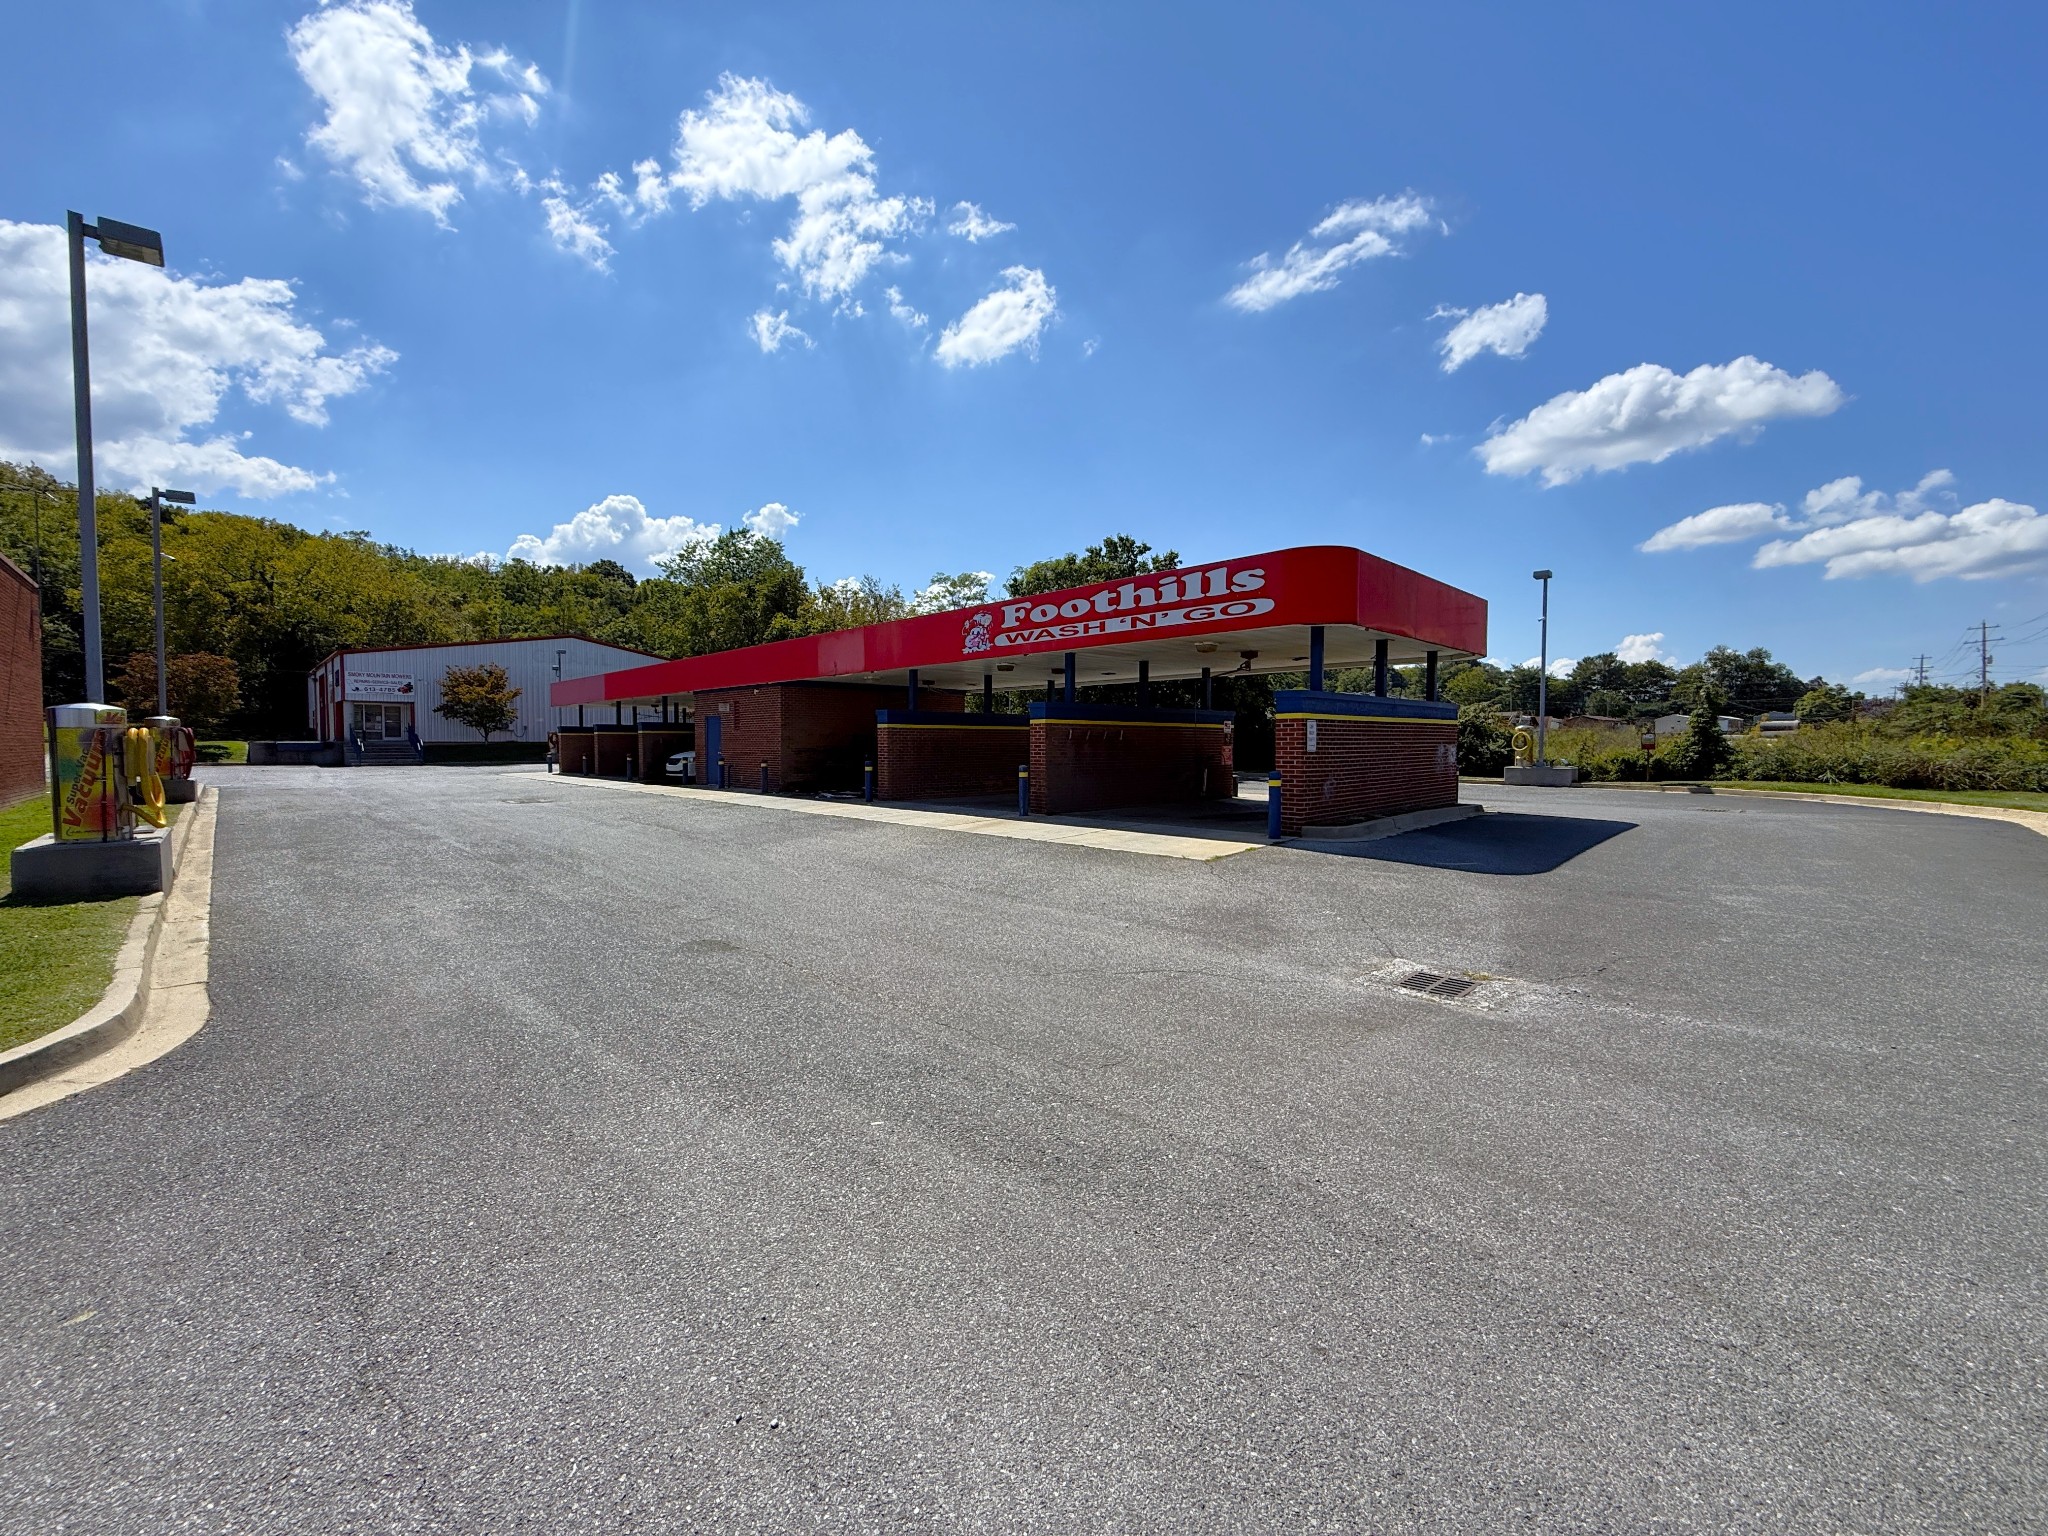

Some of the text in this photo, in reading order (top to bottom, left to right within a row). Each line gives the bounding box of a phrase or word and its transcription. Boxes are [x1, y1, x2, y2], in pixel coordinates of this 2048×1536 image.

[1000, 567, 1266, 628] Foothills
[1004, 619, 1106, 642] WASH
[1183, 601, 1258, 621] GO
[66, 748, 90, 805] Super Vac
